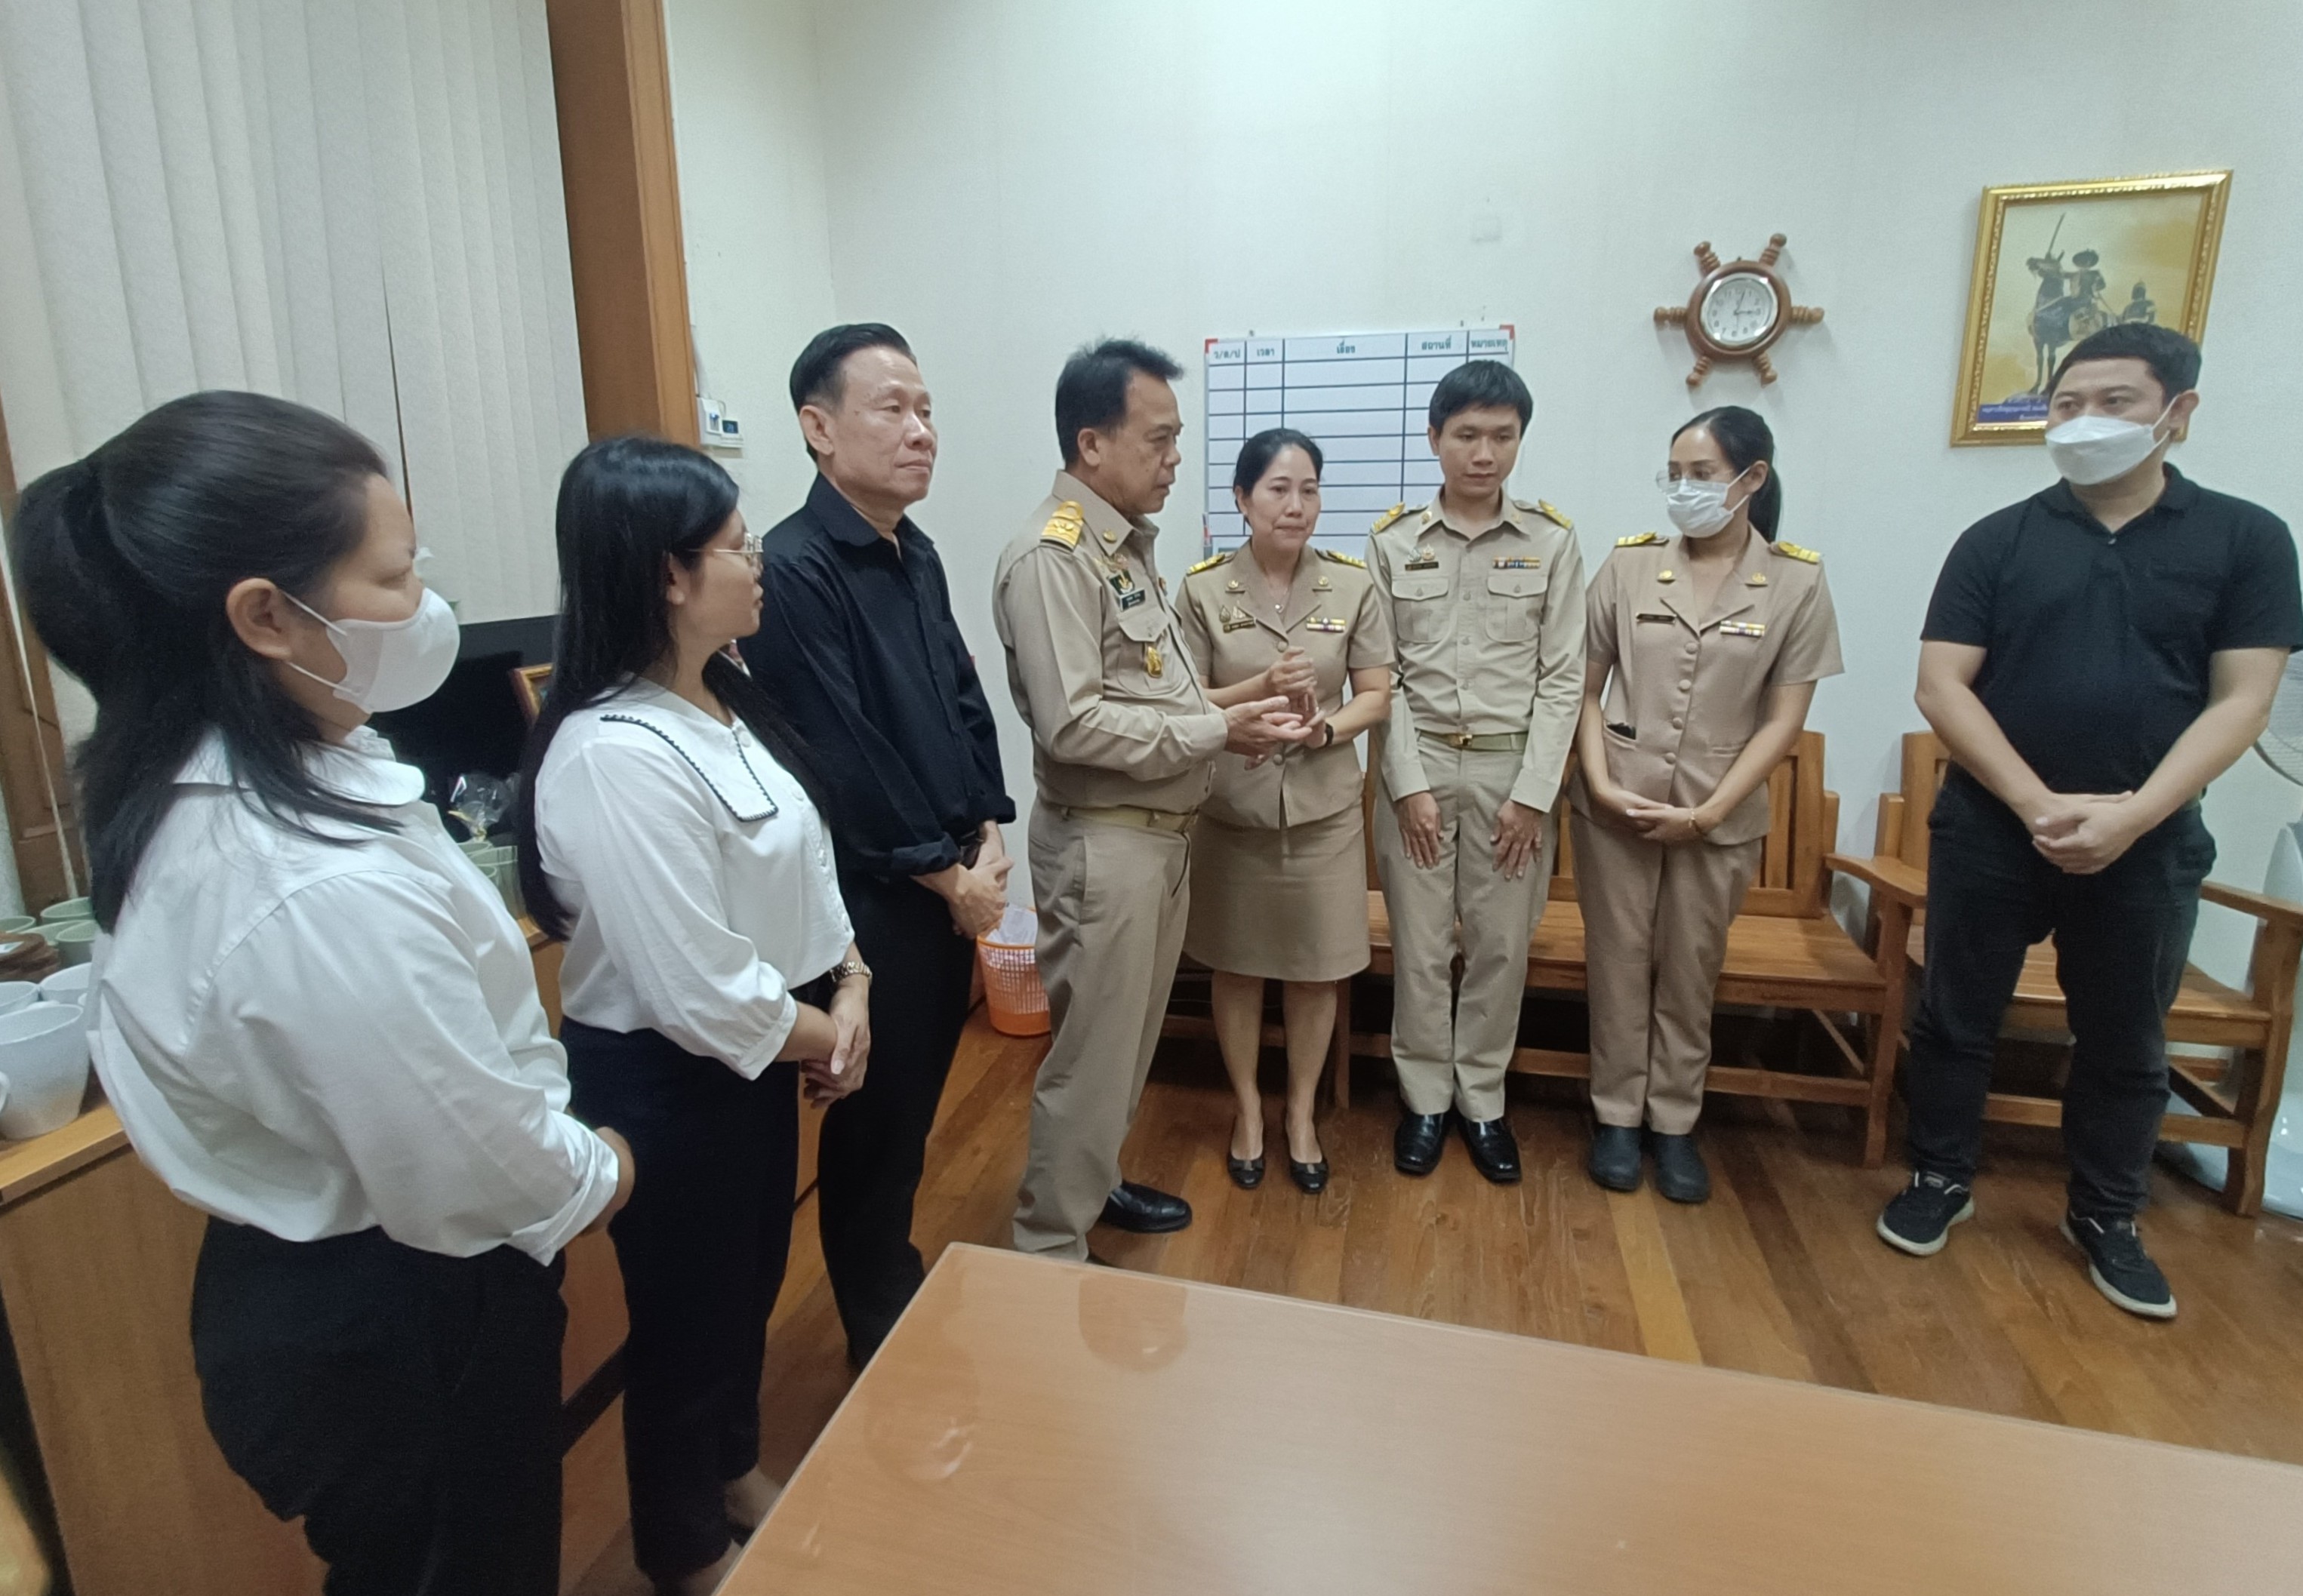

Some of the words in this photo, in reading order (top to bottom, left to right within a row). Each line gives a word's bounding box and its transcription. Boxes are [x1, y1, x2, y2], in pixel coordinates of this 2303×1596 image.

[1337, 340, 1356, 354] เรื่อง
[1421, 334, 1452, 351] สถานที่
[1470, 338, 1508, 352] หมายเหตุ
[1257, 348, 1275, 357] เวลา
